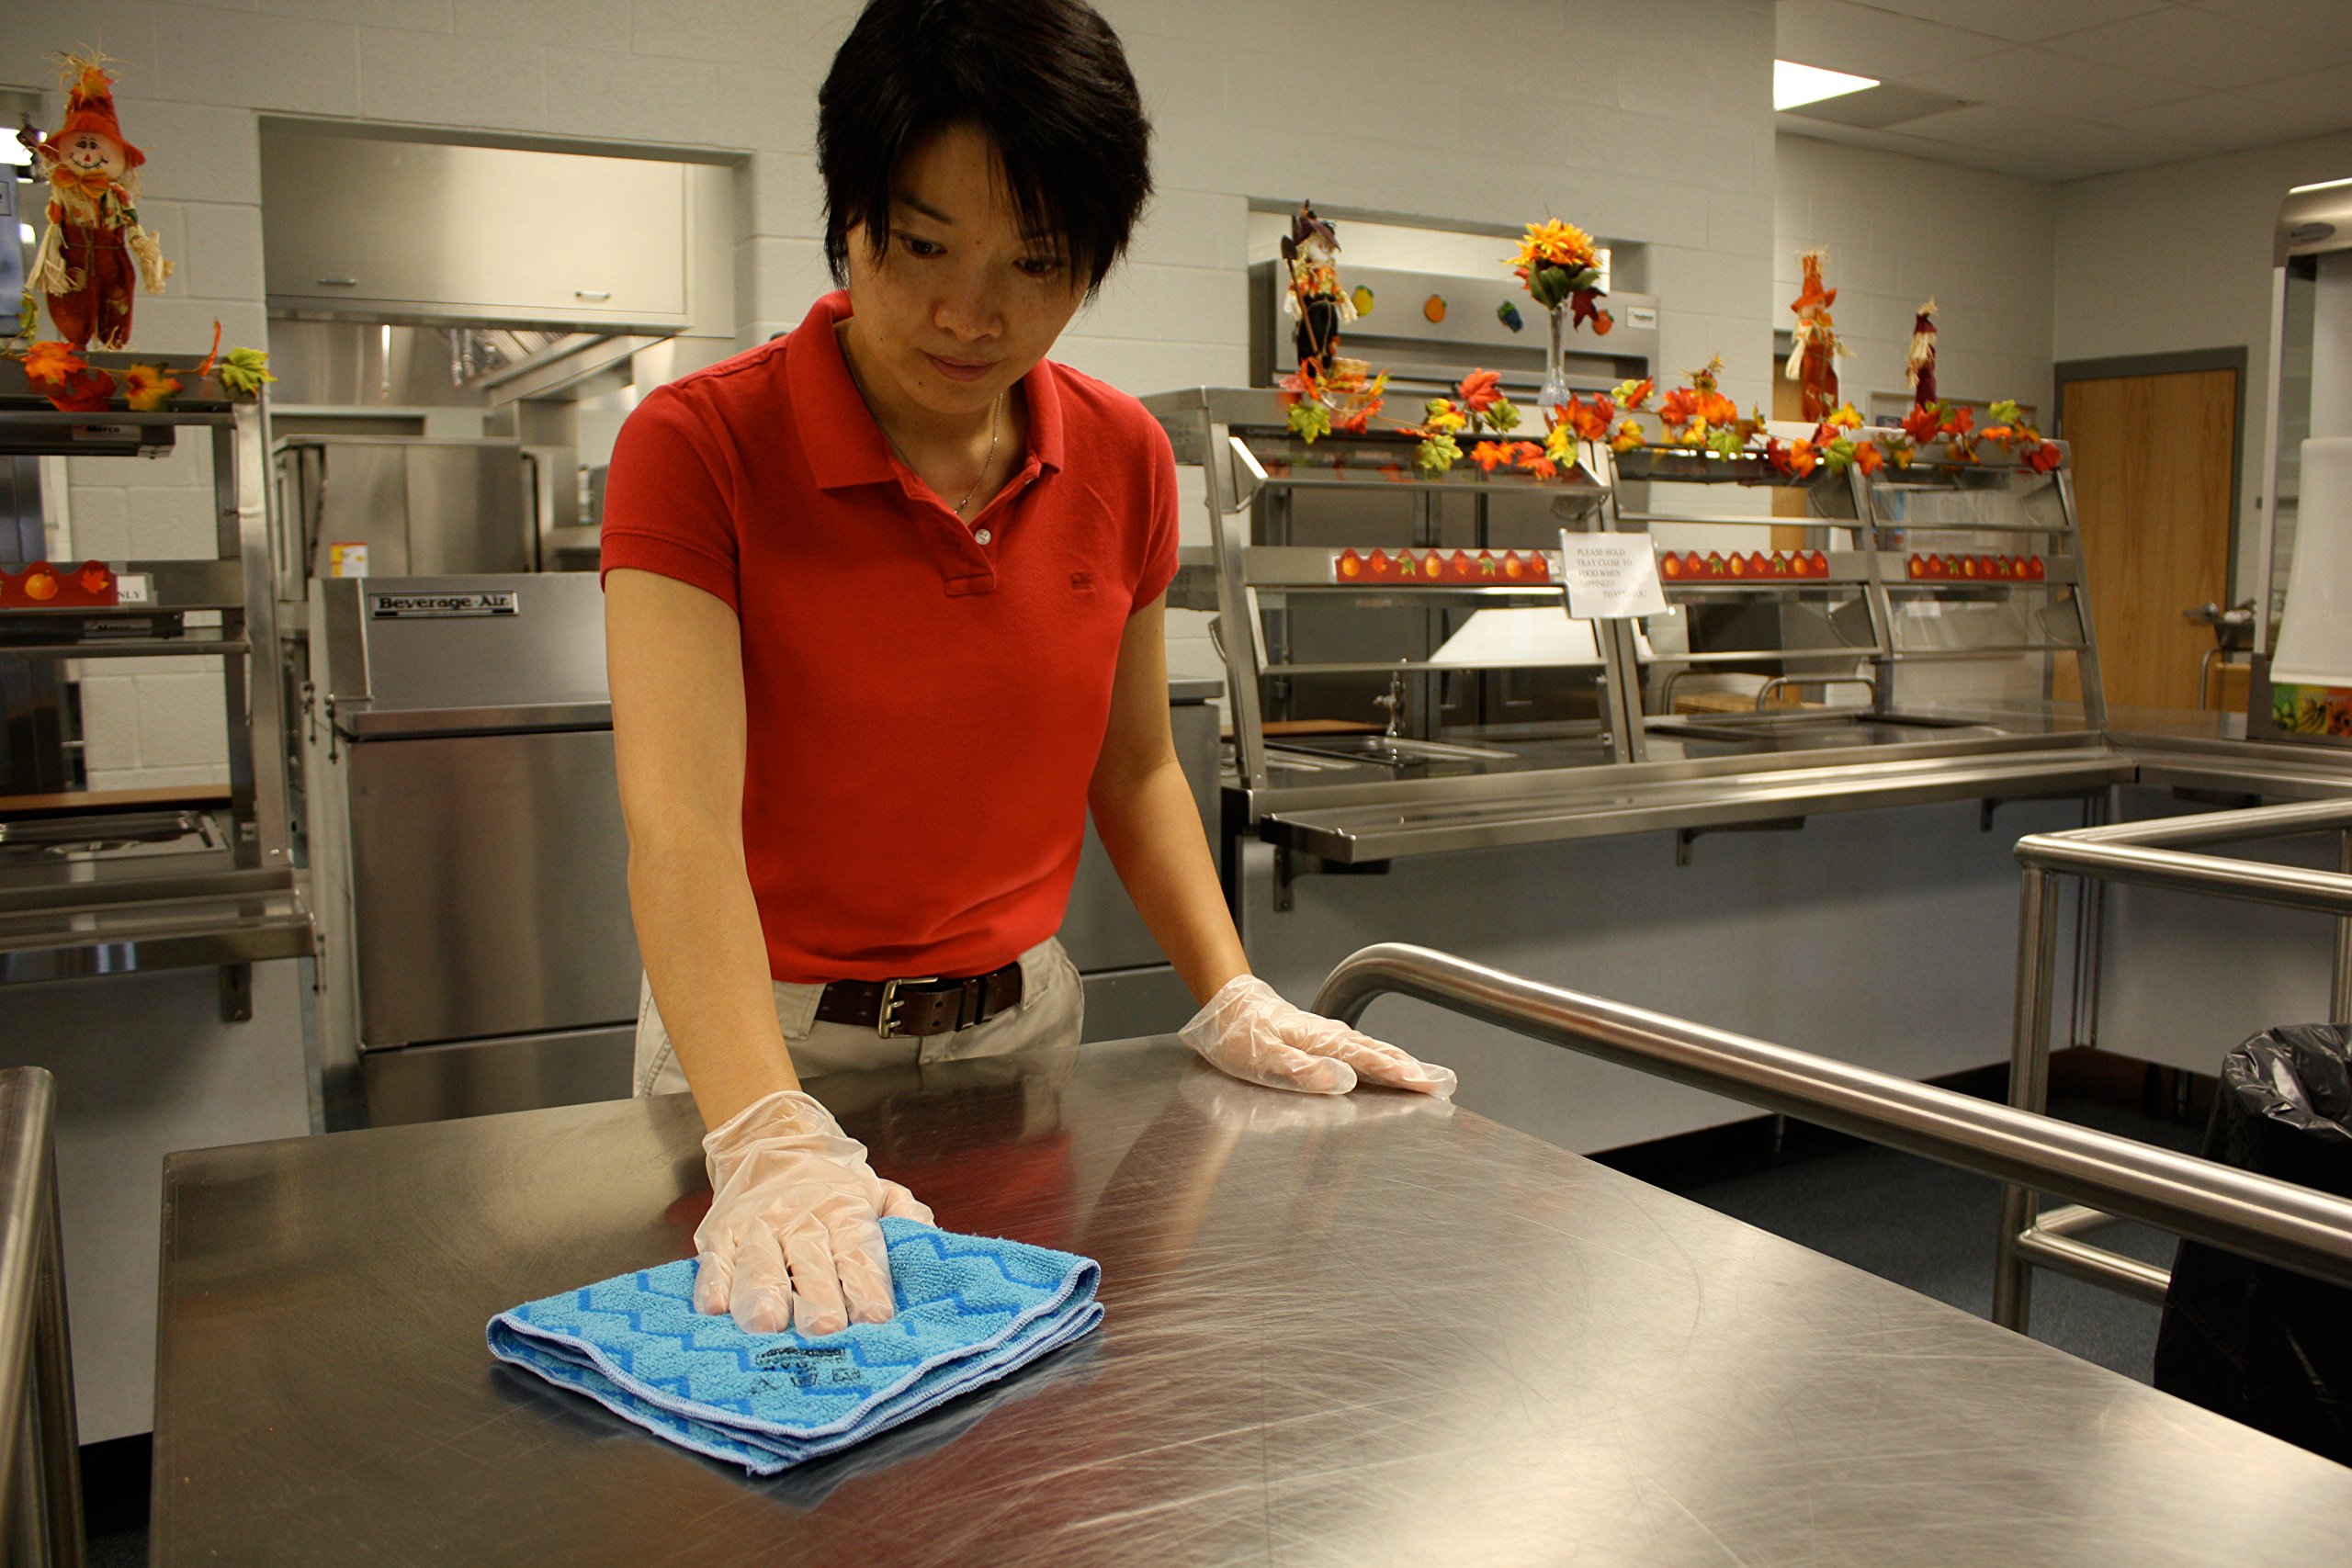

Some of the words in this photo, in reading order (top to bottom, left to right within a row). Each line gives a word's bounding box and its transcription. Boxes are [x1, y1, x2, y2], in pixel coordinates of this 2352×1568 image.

[1577, 548, 1603, 557] PLEASE
[1605, 548, 1625, 557] HOLD
[1577, 558, 1597, 567] TRAY
[1598, 558, 1620, 567] CLOSE
[1622, 558, 1633, 568] TO
[1578, 569, 1599, 577] FOOD
[1599, 569, 1622, 577] WHEN
